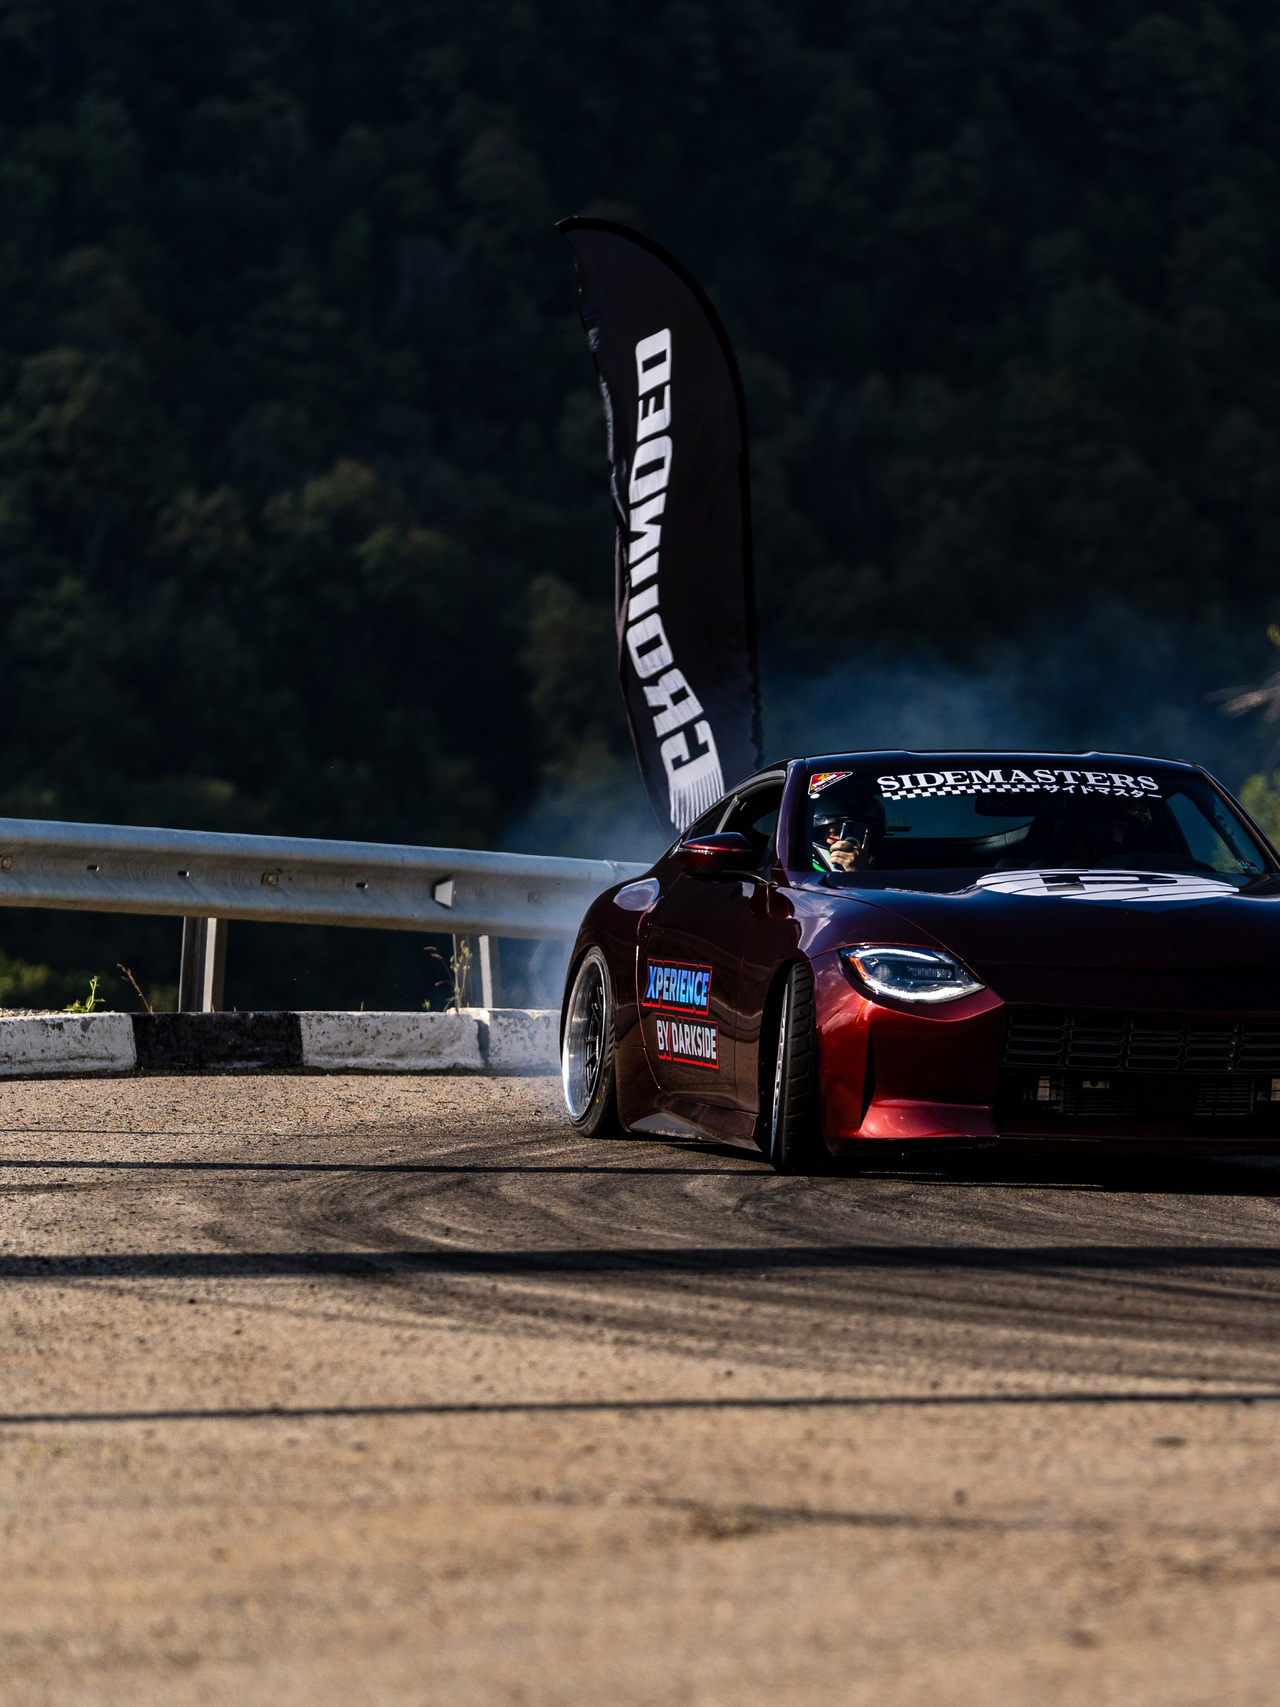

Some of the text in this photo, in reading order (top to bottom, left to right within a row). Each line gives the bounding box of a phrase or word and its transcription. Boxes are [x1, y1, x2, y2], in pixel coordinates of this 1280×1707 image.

[877, 769, 1159, 791] SIDEMASTERS
[1043, 784, 1162, 798] サイドマスター
[646, 966, 710, 1006] XPERIENCE
[656, 1020, 717, 1060] BY DARKSIDE
